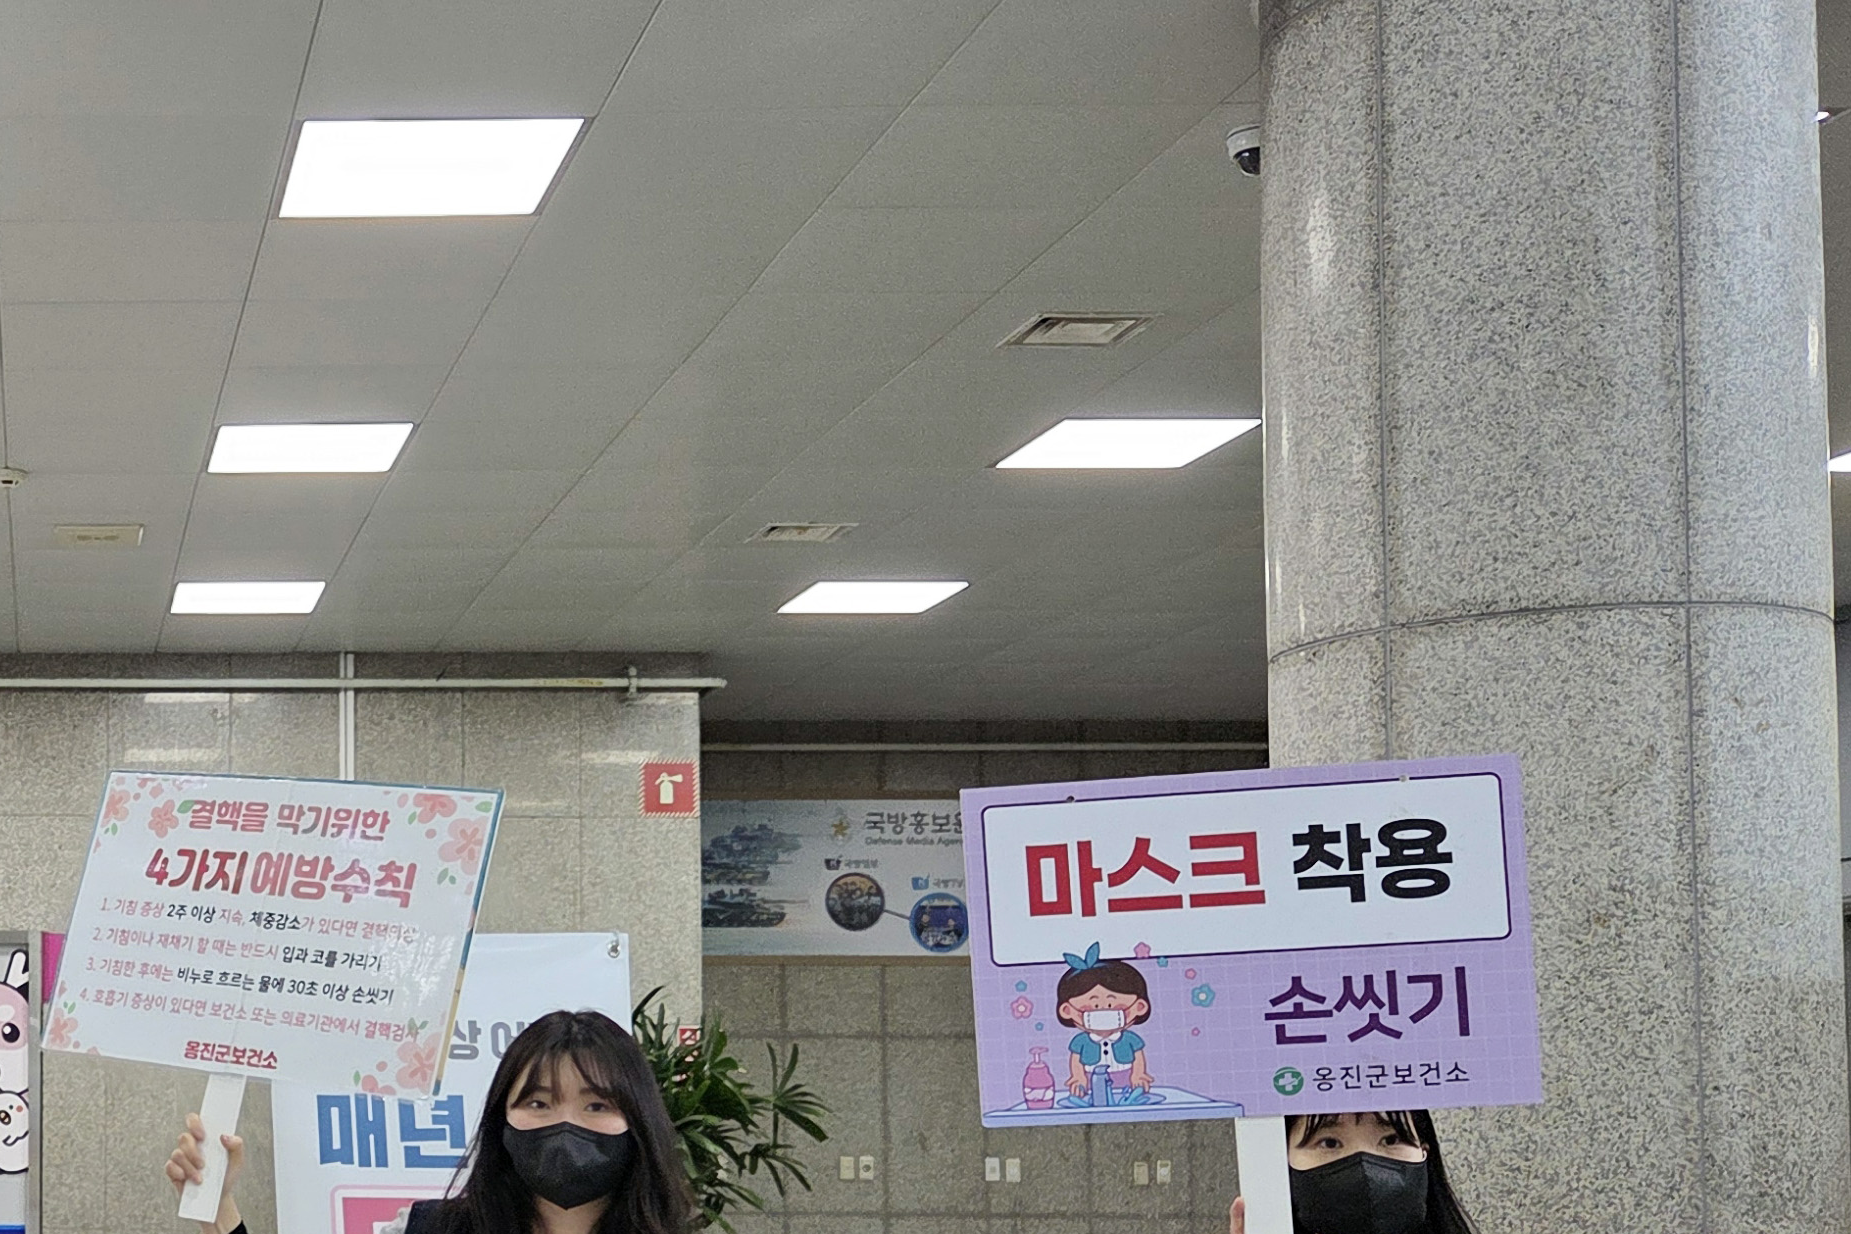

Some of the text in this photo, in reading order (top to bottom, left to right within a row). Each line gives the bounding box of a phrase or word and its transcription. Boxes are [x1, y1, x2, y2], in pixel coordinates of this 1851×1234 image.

[189, 800, 391, 842] 결핵을 막기위한
[1024, 817, 1454, 918] 마스크 착용
[114, 898, 139, 916] 기침
[140, 901, 165, 919] 증상
[166, 903, 187, 921] 2주
[190, 904, 216, 924] 이상
[317, 917, 359, 938] 있다면
[106, 927, 154, 947] 기침이나
[156, 932, 195, 950] 재채기
[197, 936, 210, 955] 할
[212, 938, 237, 958] 때는
[240, 942, 279, 961] 반드시
[282, 945, 309, 964] 입과
[310, 949, 338, 969] 코를
[340, 951, 383, 973] 가리기
[99, 958, 136, 978] 기침한
[138, 961, 174, 983] 후에는
[177, 966, 214, 985] 비누로
[215, 970, 255, 992] 흐르는
[258, 974, 286, 995] 물에
[287, 979, 319, 997] 30초
[322, 982, 349, 1002] 이상
[352, 986, 395, 1006] 손씻기
[1263, 965, 1473, 1047] 손씻기
[92, 988, 129, 1007] 호흡기
[131, 992, 167, 1011] 증상이
[169, 996, 207, 1018] 있다면
[209, 1000, 248, 1021] 보건소
[250, 1006, 278, 1028] 또는
[279, 1010, 361, 1036] 의료기관에서
[1311, 1060, 1471, 1093] 옹진군보건소
[317, 1093, 469, 1169] 매년
